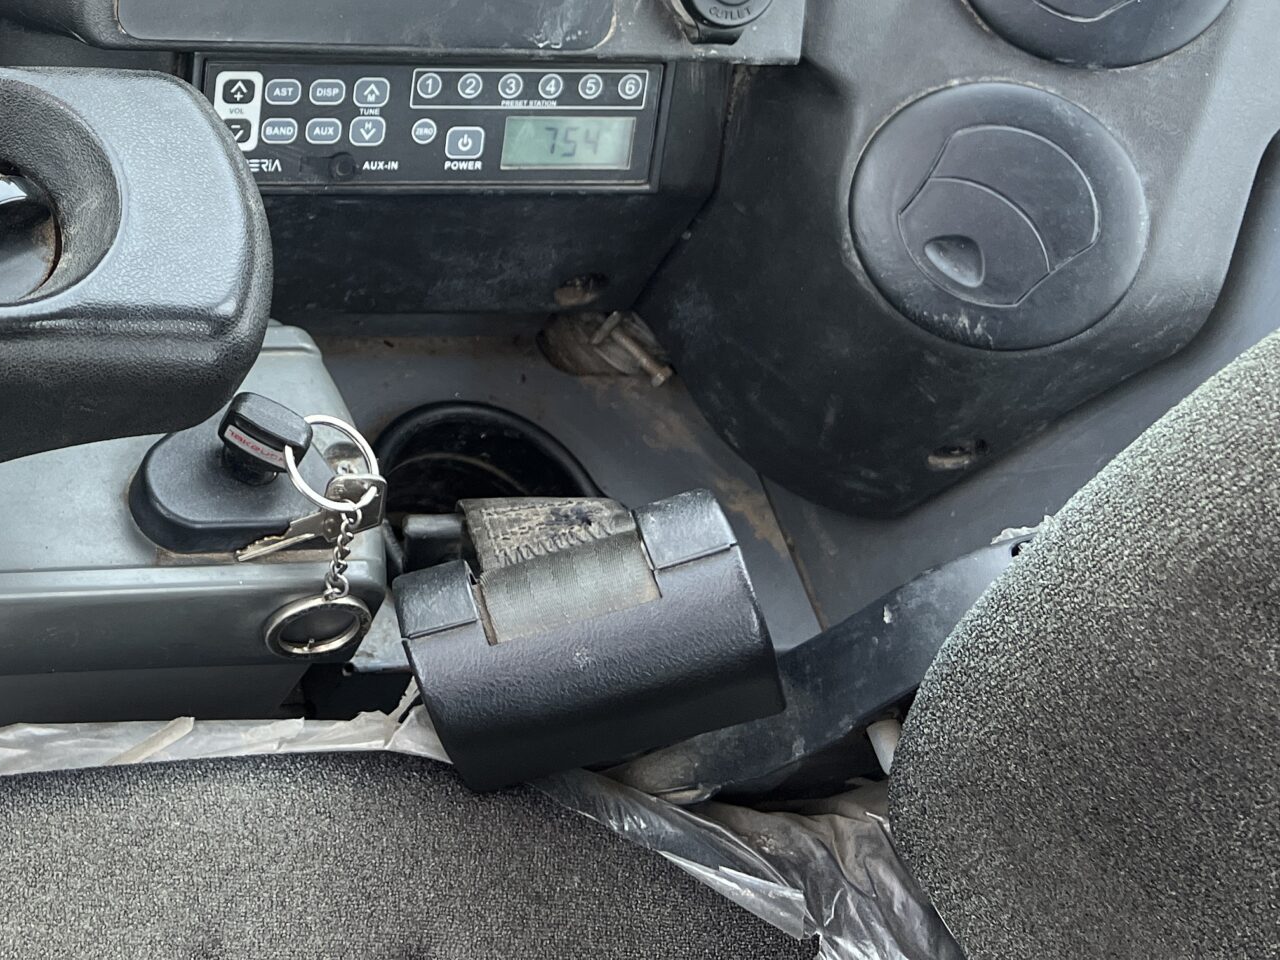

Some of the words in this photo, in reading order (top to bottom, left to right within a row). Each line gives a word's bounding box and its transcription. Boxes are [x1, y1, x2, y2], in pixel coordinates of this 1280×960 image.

[709, 7, 753, 20] OUTLET
[425, 78, 432, 93] 1
[465, 79, 476, 93] 2
[505, 79, 516, 93] 3
[545, 80, 556, 93] 4
[586, 80, 596, 93] 5
[625, 80, 636, 93] 6
[273, 88, 293, 96] AST
[316, 88, 339, 96] DISP
[266, 127, 293, 135] BAND
[314, 127, 334, 135] AUX
[416, 127, 433, 136] ZERO
[363, 161, 399, 170] AUX-IN
[444, 161, 482, 170] POWER
